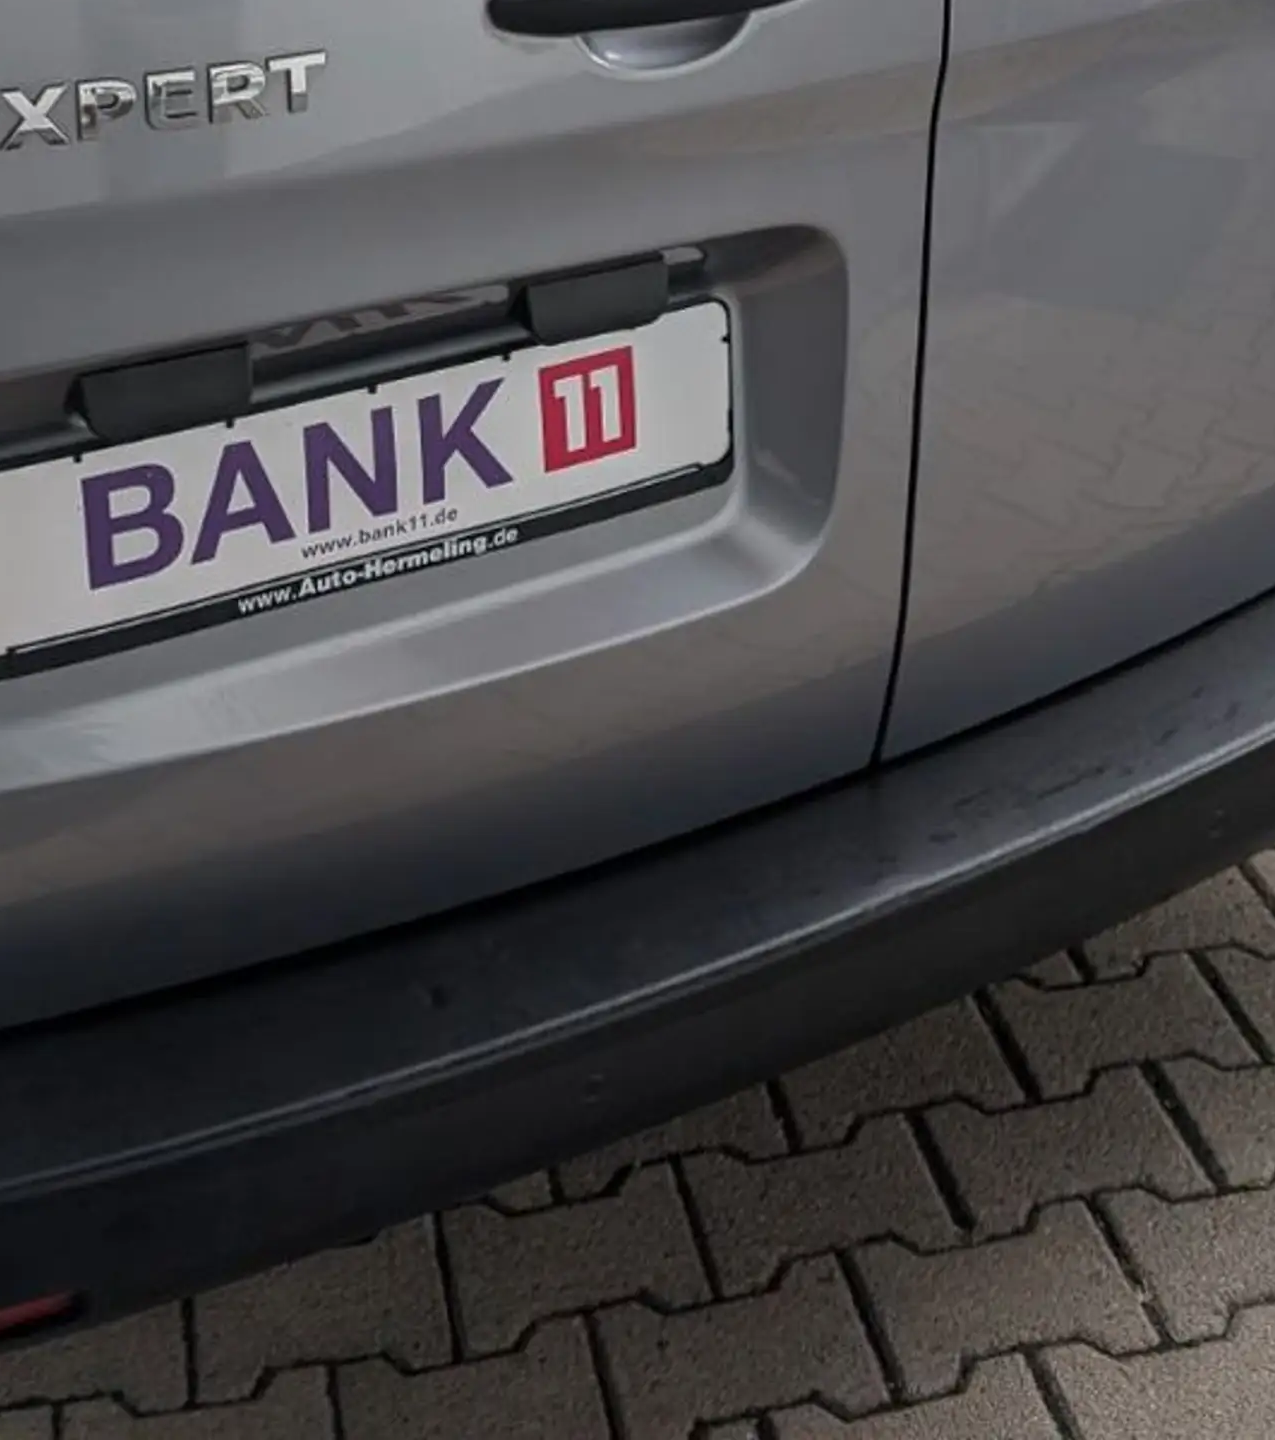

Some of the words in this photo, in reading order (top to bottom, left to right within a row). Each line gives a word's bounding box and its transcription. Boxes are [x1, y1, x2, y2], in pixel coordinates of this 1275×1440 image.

[79, 376, 514, 591] BANK
[551, 360, 626, 456] 11
[237, 525, 520, 614] www.Auto-Hermeling.de
[300, 507, 459, 560] www.bank11.de
